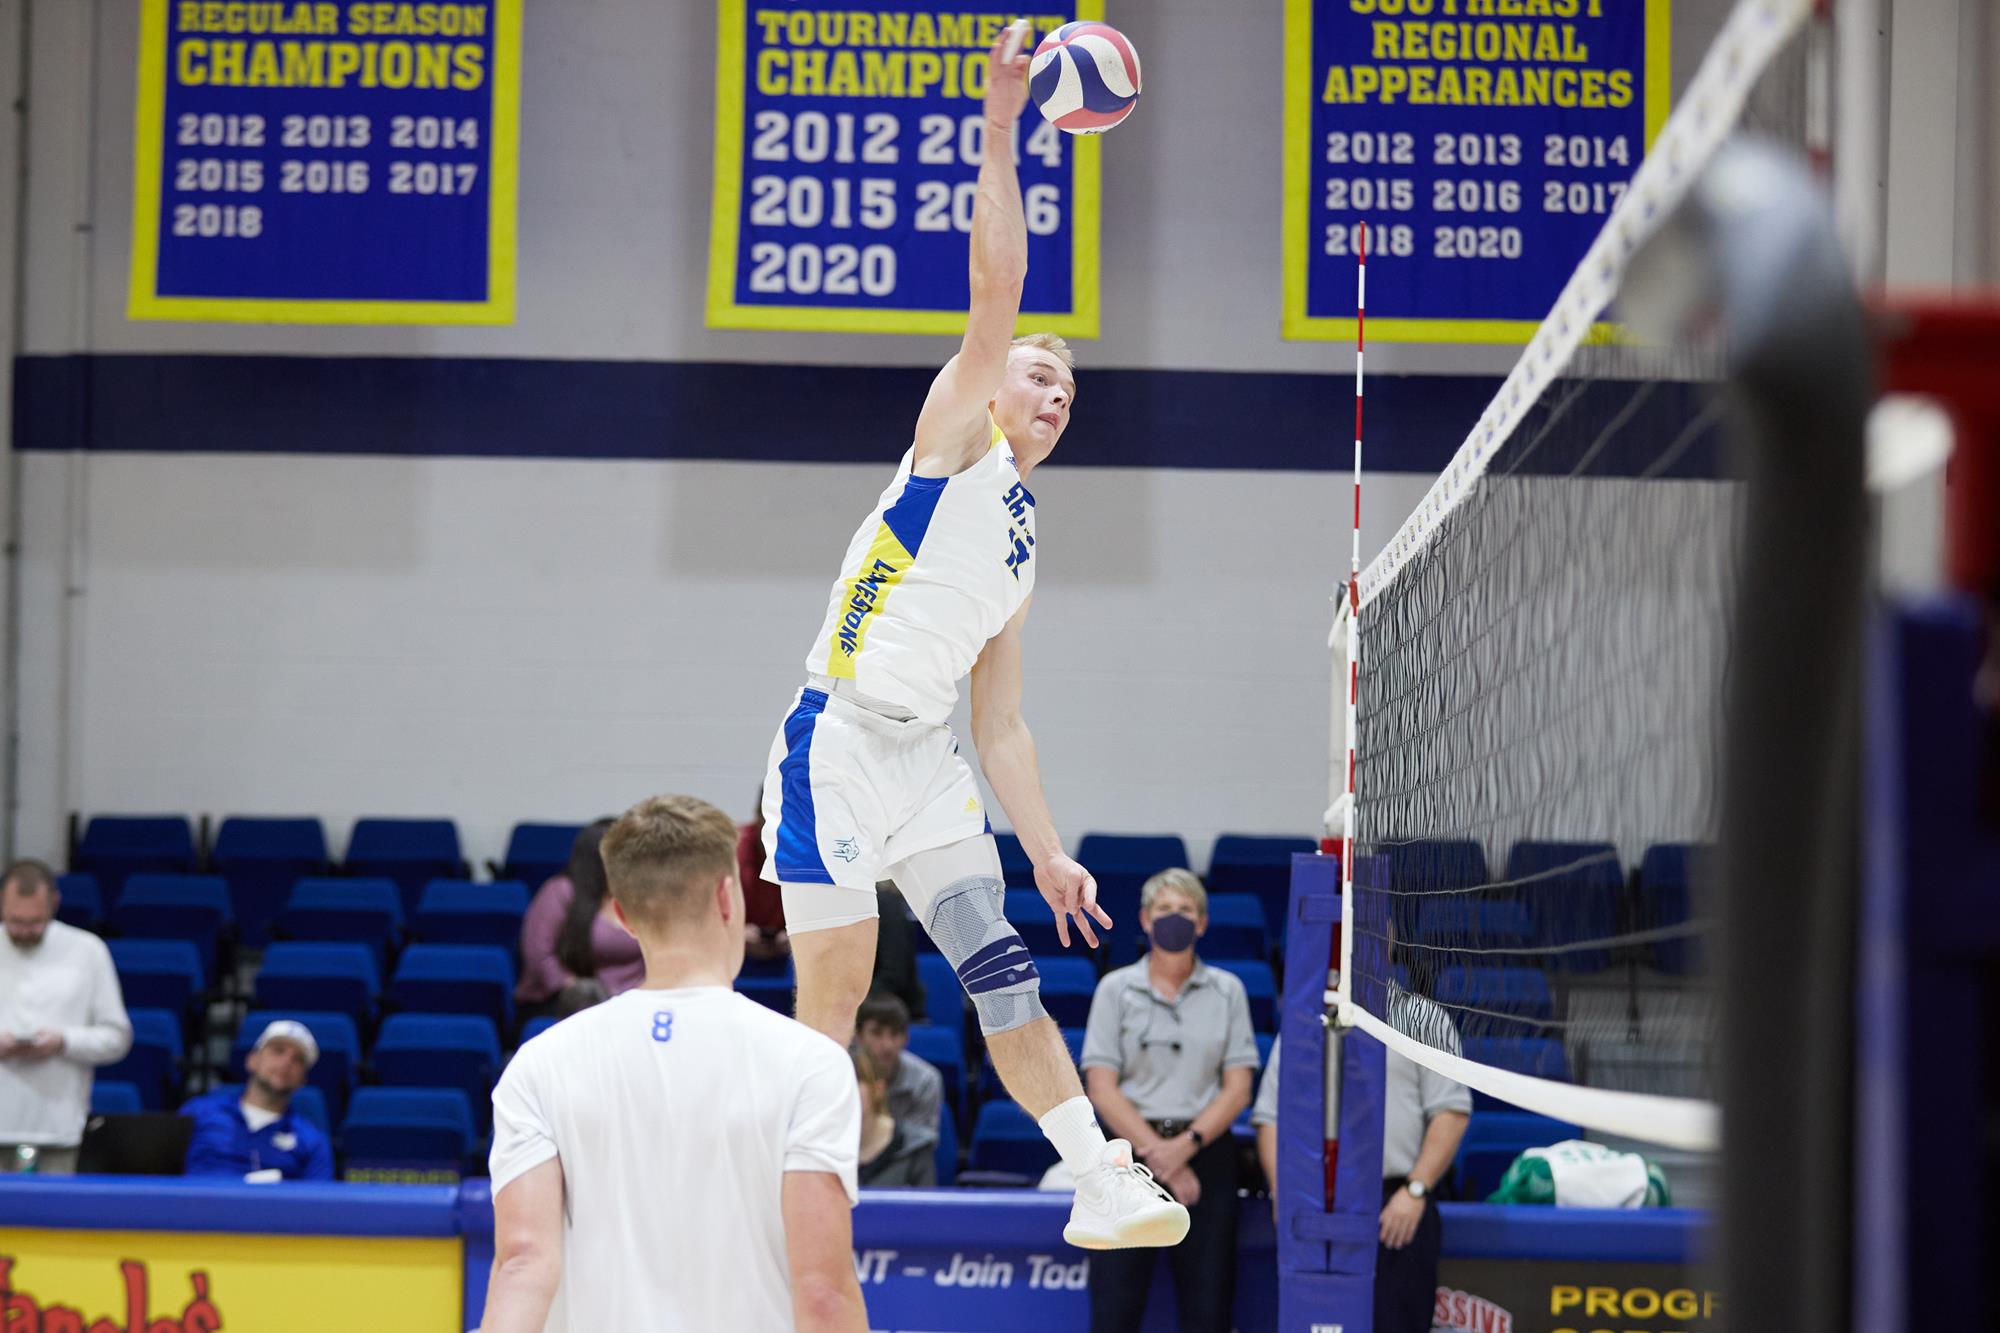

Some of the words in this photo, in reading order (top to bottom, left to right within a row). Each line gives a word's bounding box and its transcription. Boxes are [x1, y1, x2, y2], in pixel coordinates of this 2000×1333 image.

[178, 1, 338, 34] REGULAR
[348, 3, 486, 36] SEASON
[1372, 21, 1588, 62] REGIONAL
[178, 39, 484, 90] CHAMPIONS
[756, 49, 991, 99] CHAMPIO
[1322, 66, 1633, 108] APPEARANCES
[177, 113, 265, 147] 2012
[281, 115, 371, 148] 2013
[390, 116, 478, 149] 2014
[752, 110, 899, 163] 2012
[1326, 131, 1414, 164] 2012
[1433, 133, 1521, 166] 2013
[1544, 134, 1629, 167] 2014
[175, 159, 263, 192] 2015
[280, 160, 369, 193] 2016
[388, 161, 477, 195] 2017
[750, 175, 897, 229] 2015
[914, 181, 1061, 236] 206
[1326, 178, 1414, 211] 2015
[1432, 179, 1521, 212] 2016
[1543, 181, 1630, 214] 2017
[173, 204, 262, 238] 2018
[1325, 223, 1414, 257] 2018
[1434, 226, 1522, 259] 2020
[749, 242, 897, 296] 2020
[651, 1010, 672, 1042] 8
[933, 1253, 1014, 1289] Join
[1027, 1255, 1091, 1290] Tod
